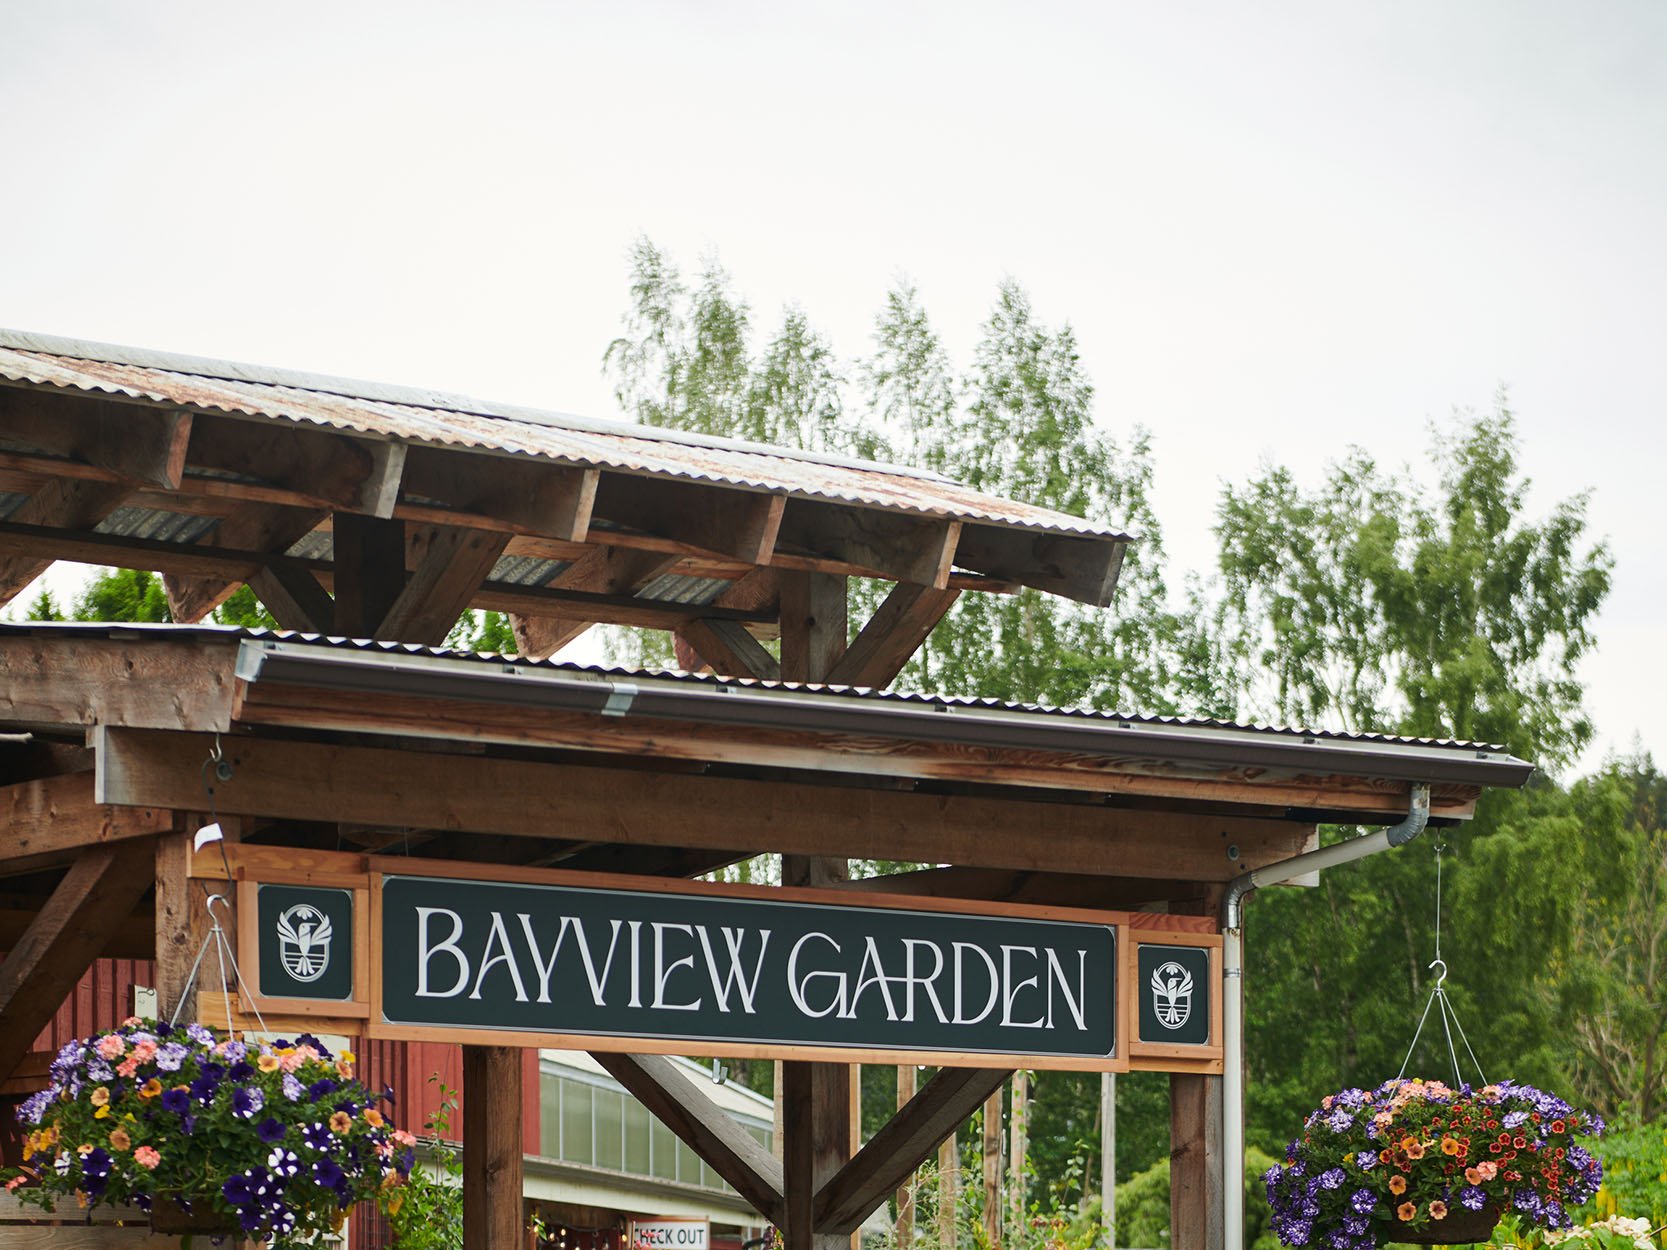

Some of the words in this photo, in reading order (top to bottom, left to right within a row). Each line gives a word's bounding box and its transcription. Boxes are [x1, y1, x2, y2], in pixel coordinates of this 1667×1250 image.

[414, 906, 771, 1015] BAYVIEW
[787, 931, 1088, 1031] GARDEN
[677, 1228, 704, 1244] OUT
